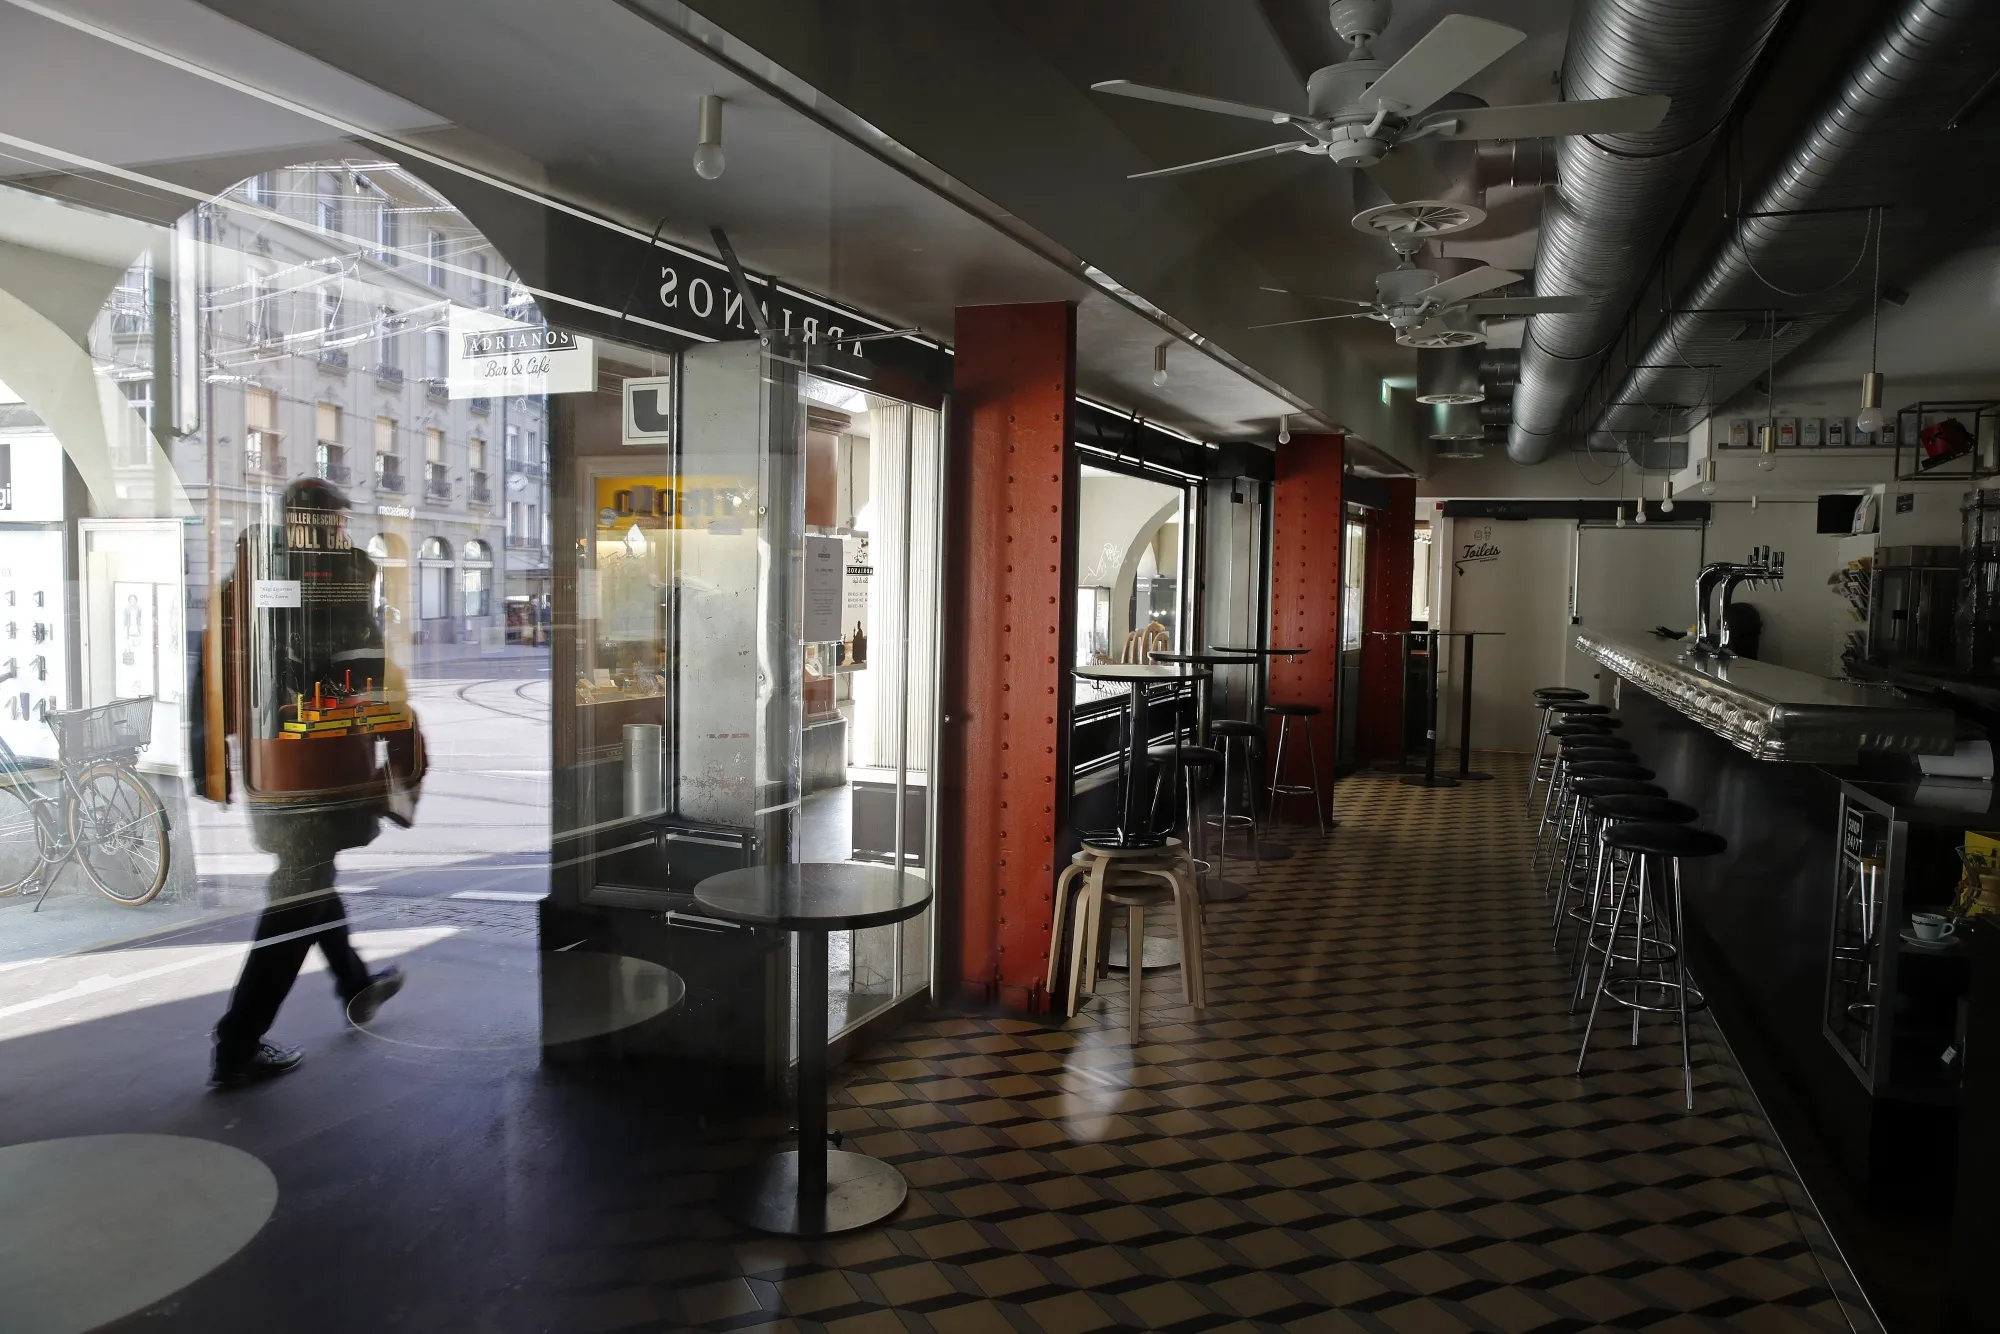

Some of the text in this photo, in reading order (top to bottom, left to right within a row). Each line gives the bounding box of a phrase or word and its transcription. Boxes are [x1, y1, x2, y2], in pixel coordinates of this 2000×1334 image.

[470, 331, 569, 352] ADRIANOS
[485, 355, 551, 378] Bar & Café
[286, 512, 311, 524] VOLLER
[286, 526, 321, 549] VOLL
[1463, 543, 1501, 559] Toilets
